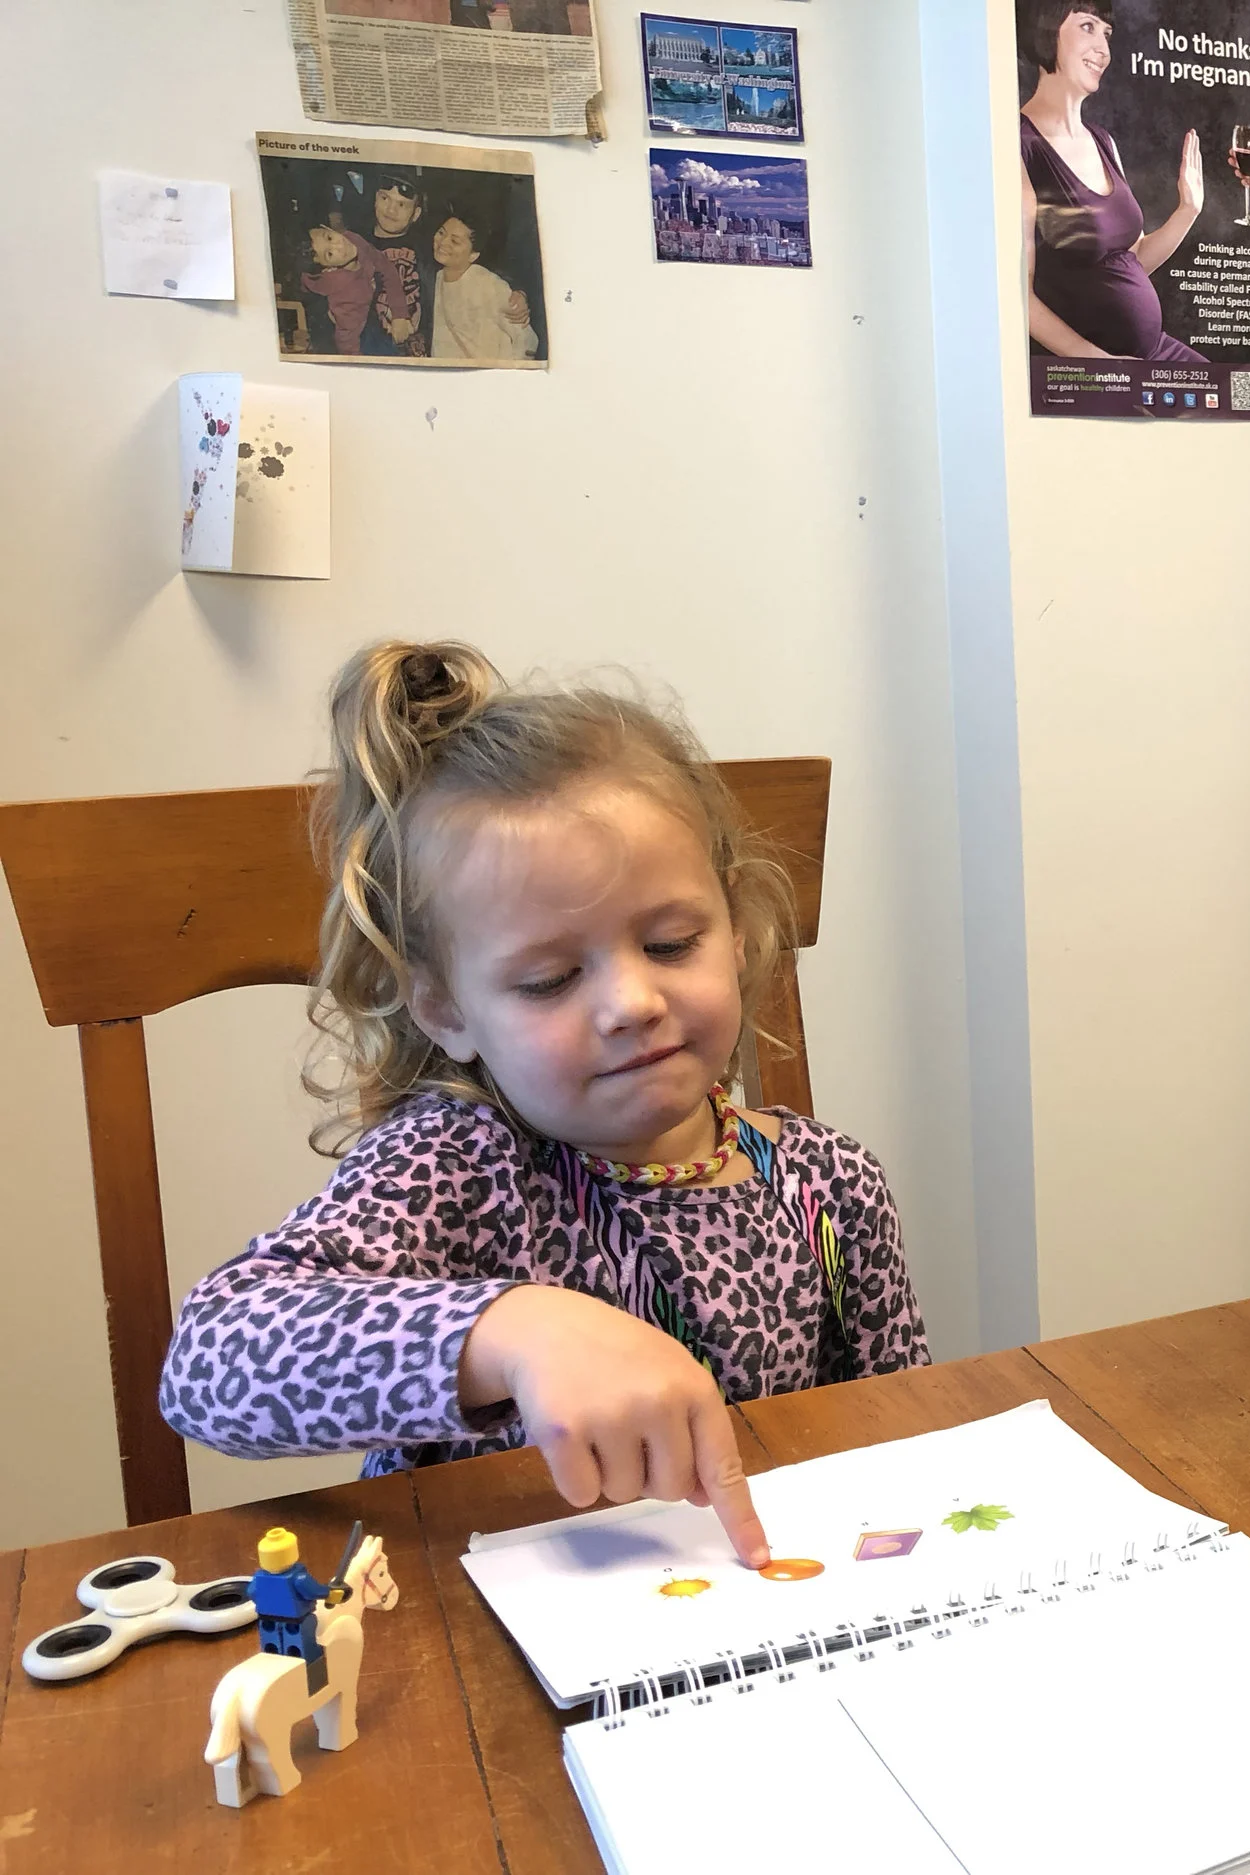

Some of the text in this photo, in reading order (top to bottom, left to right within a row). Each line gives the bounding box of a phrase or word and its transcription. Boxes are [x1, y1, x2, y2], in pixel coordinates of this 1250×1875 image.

[1158, 28, 1188, 52] No
[1131, 52, 1164, 77] I'm
[258, 138, 360, 154] Picture of the week
[658, 230, 810, 263] SEATTLE
[1198, 243, 1235, 256] Drinking
[1193, 256, 1222, 268] during
[1170, 269, 1186, 277] can
[1187, 270, 1211, 279] cause
[1213, 271, 1219, 279] a
[1179, 281, 1219, 294] disability
[1219, 284, 1244, 294] called
[1193, 295, 1225, 306] Alcohol
[1198, 308, 1234, 319] Disorder
[1207, 322, 1231, 332] Learn
[1190, 335, 1220, 345] protect
[1221, 336, 1241, 347] your
[1046, 365, 1085, 373] saskatchewan
[1151, 369, 1209, 381] (306) 655-2512
[1059, 383, 1073, 392] goal
[1105, 384, 1131, 392] children
